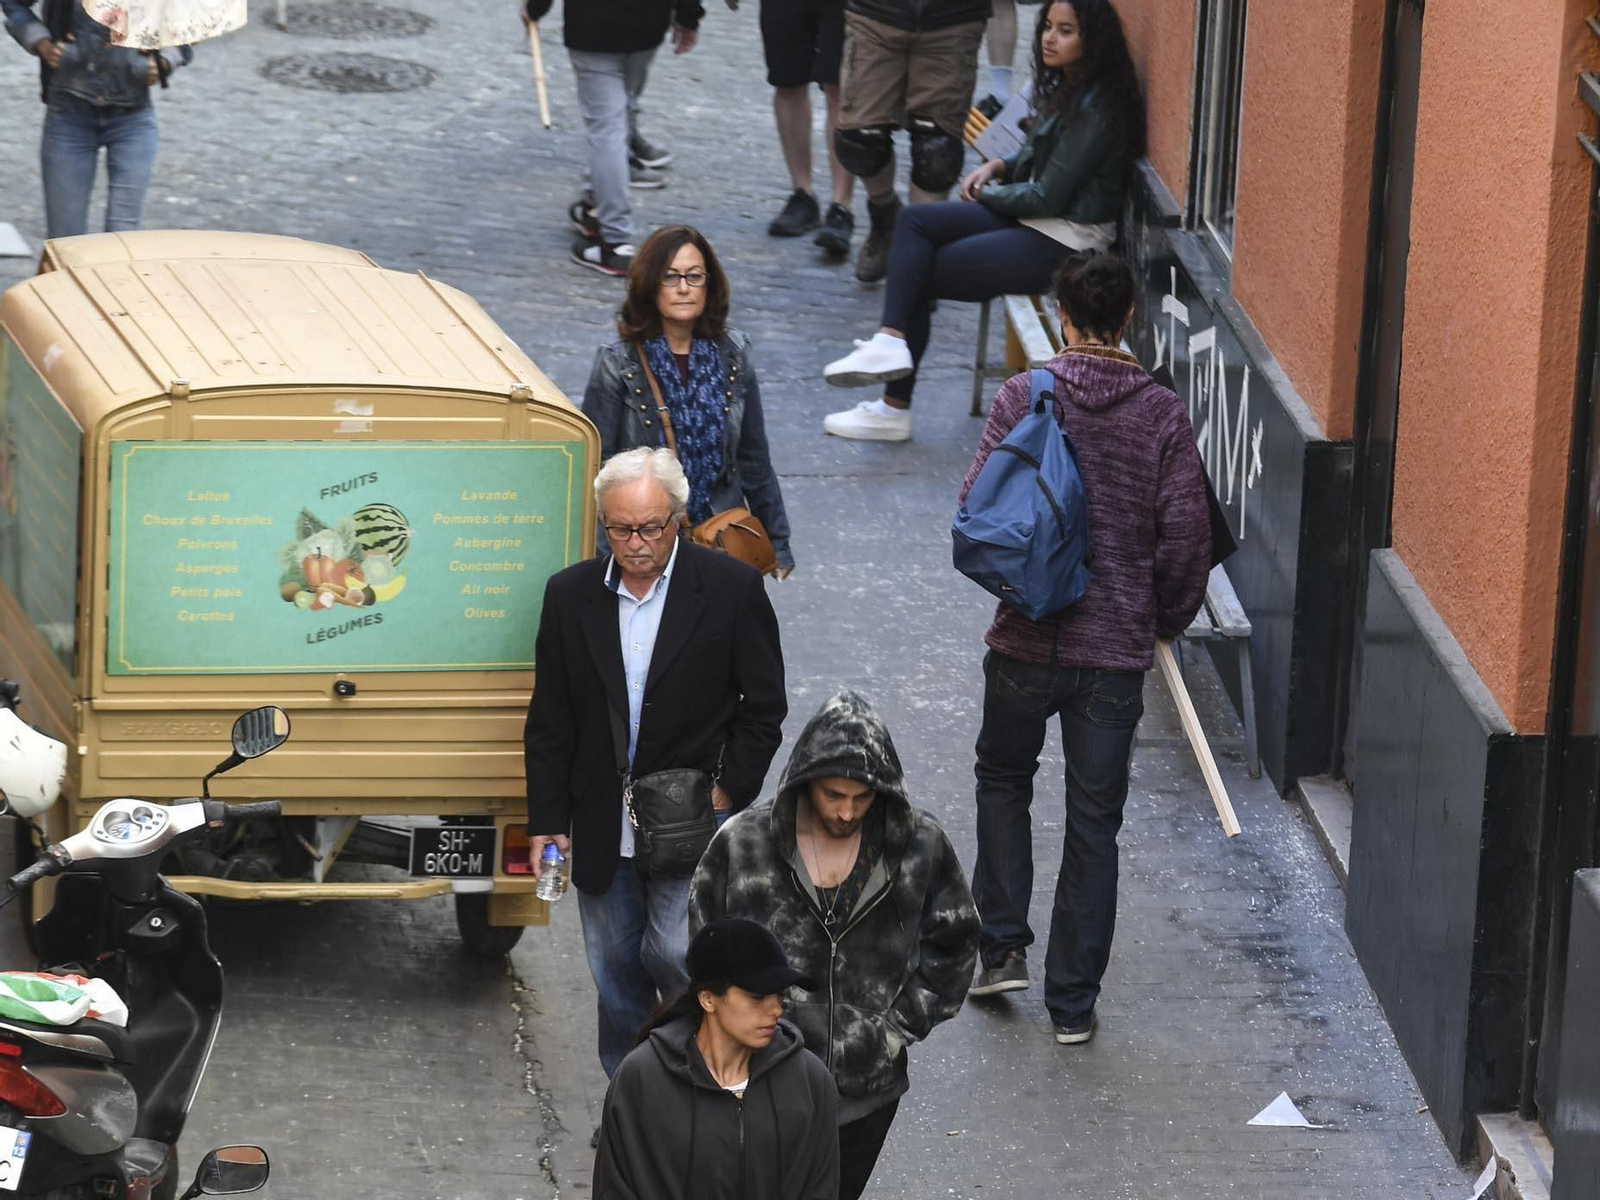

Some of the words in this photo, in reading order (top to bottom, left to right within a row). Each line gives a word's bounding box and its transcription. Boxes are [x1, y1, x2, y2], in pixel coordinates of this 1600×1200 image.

[319, 471, 378, 500] FRUITS
[461, 489, 518, 501] Lavande
[143, 514, 185, 525] Choux
[190, 514, 207, 525] de
[210, 514, 275, 525] Bruxelles
[433, 513, 490, 524] Pommes
[493, 512, 510, 524] de
[513, 513, 545, 524] terre
[178, 538, 238, 550] Poivrons
[453, 537, 523, 551] Aubergine
[175, 562, 239, 575] Asperges
[449, 561, 525, 572] Concombre
[171, 586, 208, 598] Petits
[462, 584, 480, 595] Ail
[484, 585, 511, 595] noir
[178, 610, 235, 622] Carottes
[464, 607, 506, 619] Olives
[306, 613, 384, 644] LÉGUMES
[437, 830, 471, 851] SH-
